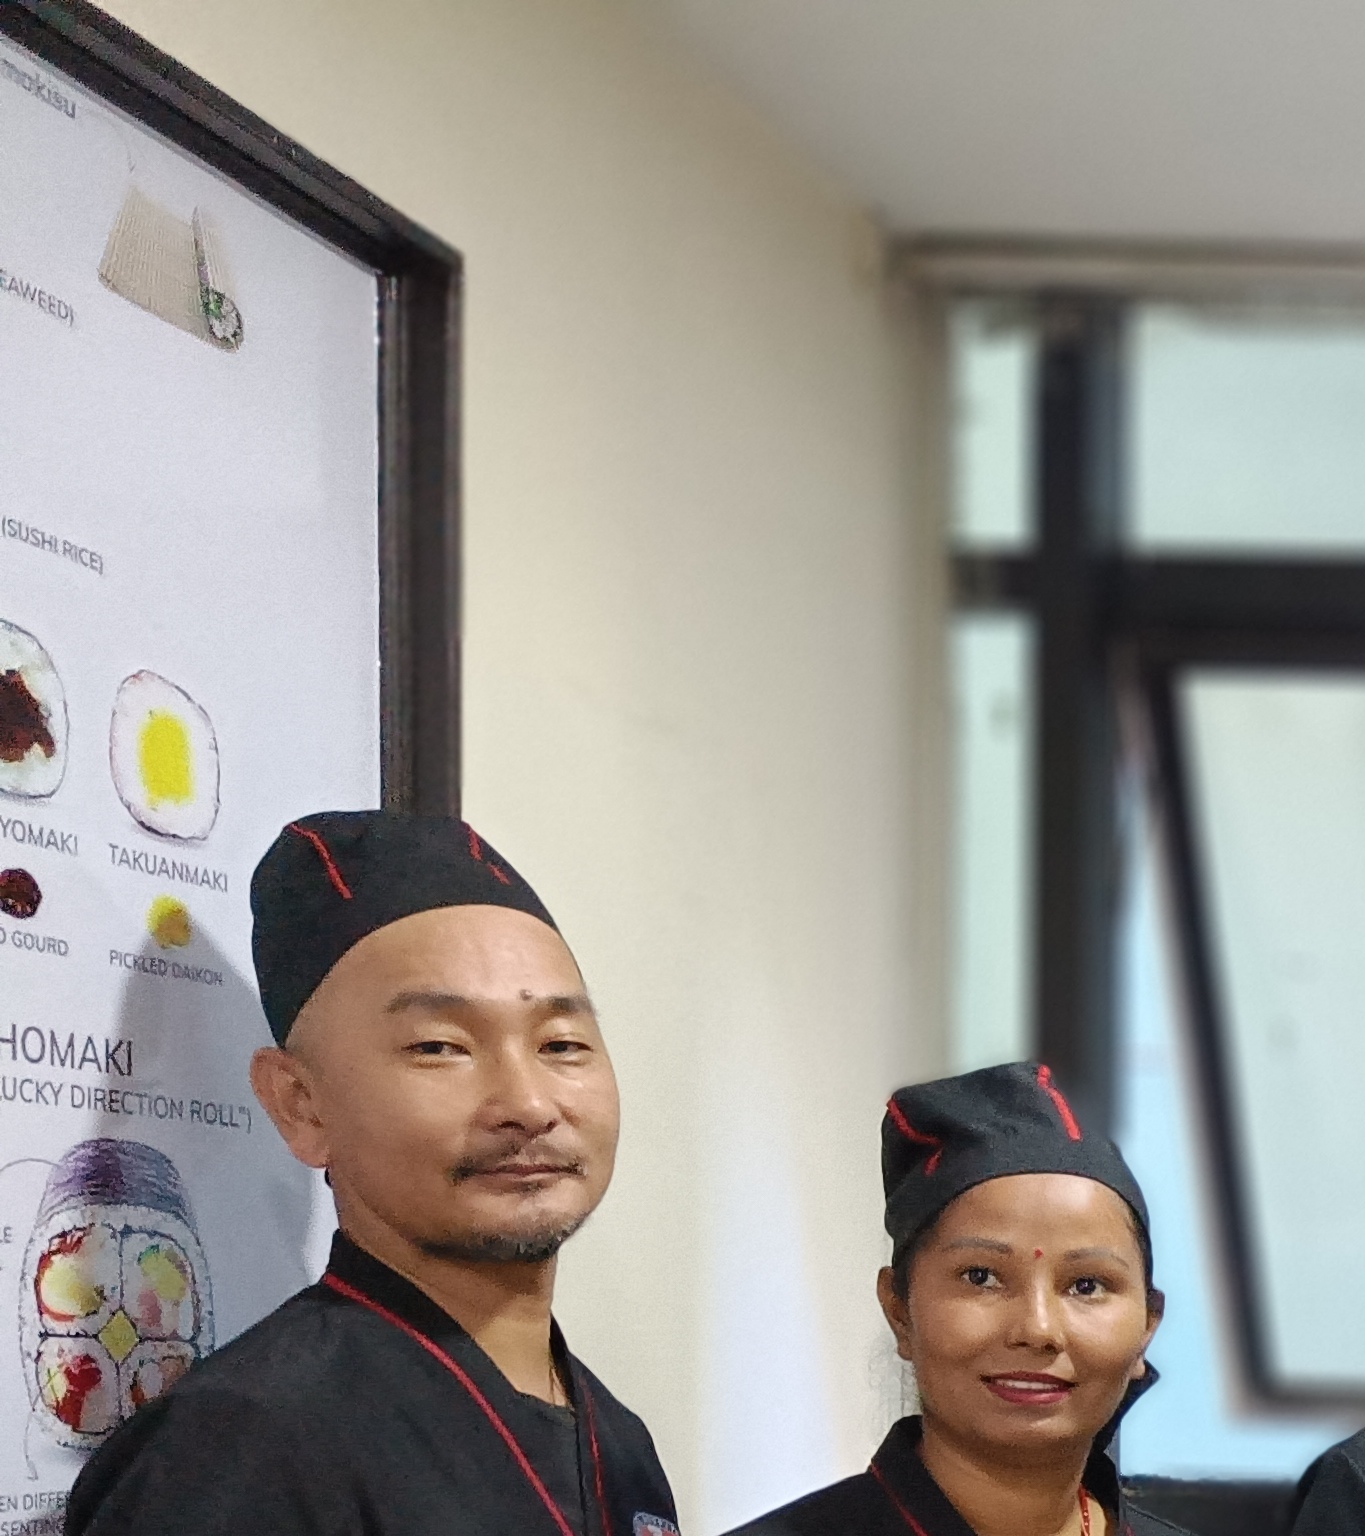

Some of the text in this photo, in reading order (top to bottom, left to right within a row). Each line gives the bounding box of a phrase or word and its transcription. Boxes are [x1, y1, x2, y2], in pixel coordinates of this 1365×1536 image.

[1, 514, 103, 576] (SUSHI RICE)
[0, 815, 78, 856] YOMAKI
[108, 843, 229, 892] TAKUANMAKI
[11, 929, 70, 957] GOURD
[109, 949, 226, 987] PICKLED DAIKON
[0, 1076, 64, 1107] UCKY
[70, 1084, 184, 1121] DIRECTION
